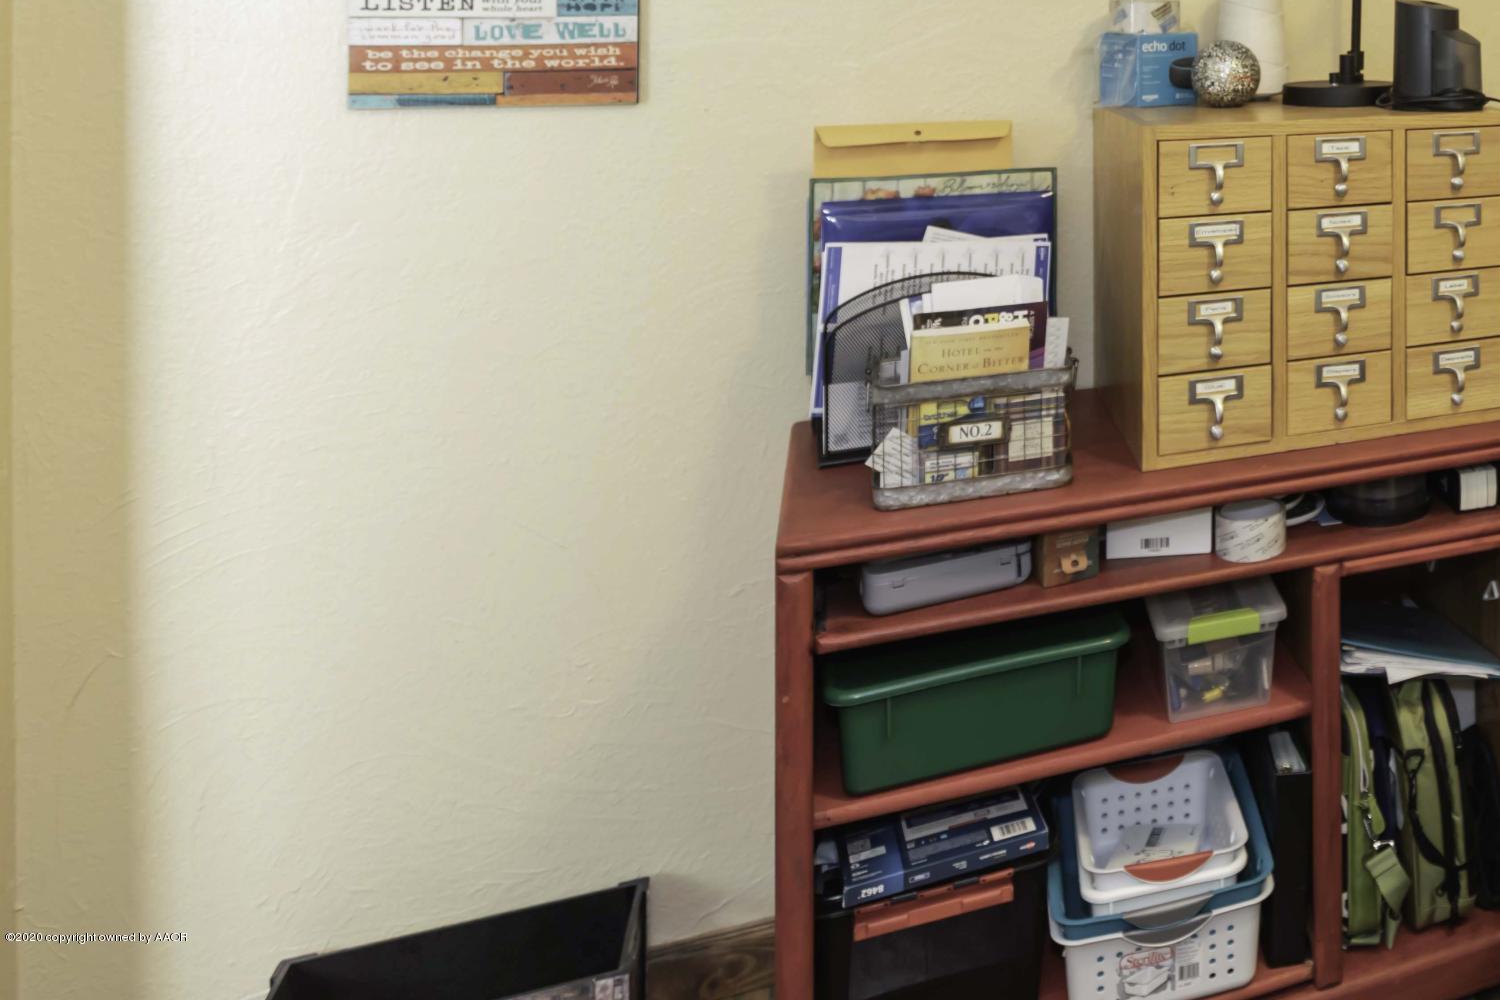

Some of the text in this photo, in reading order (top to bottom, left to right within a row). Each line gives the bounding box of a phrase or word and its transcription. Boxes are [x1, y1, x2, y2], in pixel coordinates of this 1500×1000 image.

[482, 4, 543, 12] whole heart
[474, 22, 627, 41] LOVE WELL
[365, 45, 621, 60] be the change you wish
[1142, 39, 1186, 53] echo dot
[362, 56, 625, 72] to see in the world.
[942, 347, 979, 358] HOTEL
[918, 362, 969, 375] CORNER
[983, 357, 1025, 369] BITTER
[959, 424, 993, 439] NO.2
